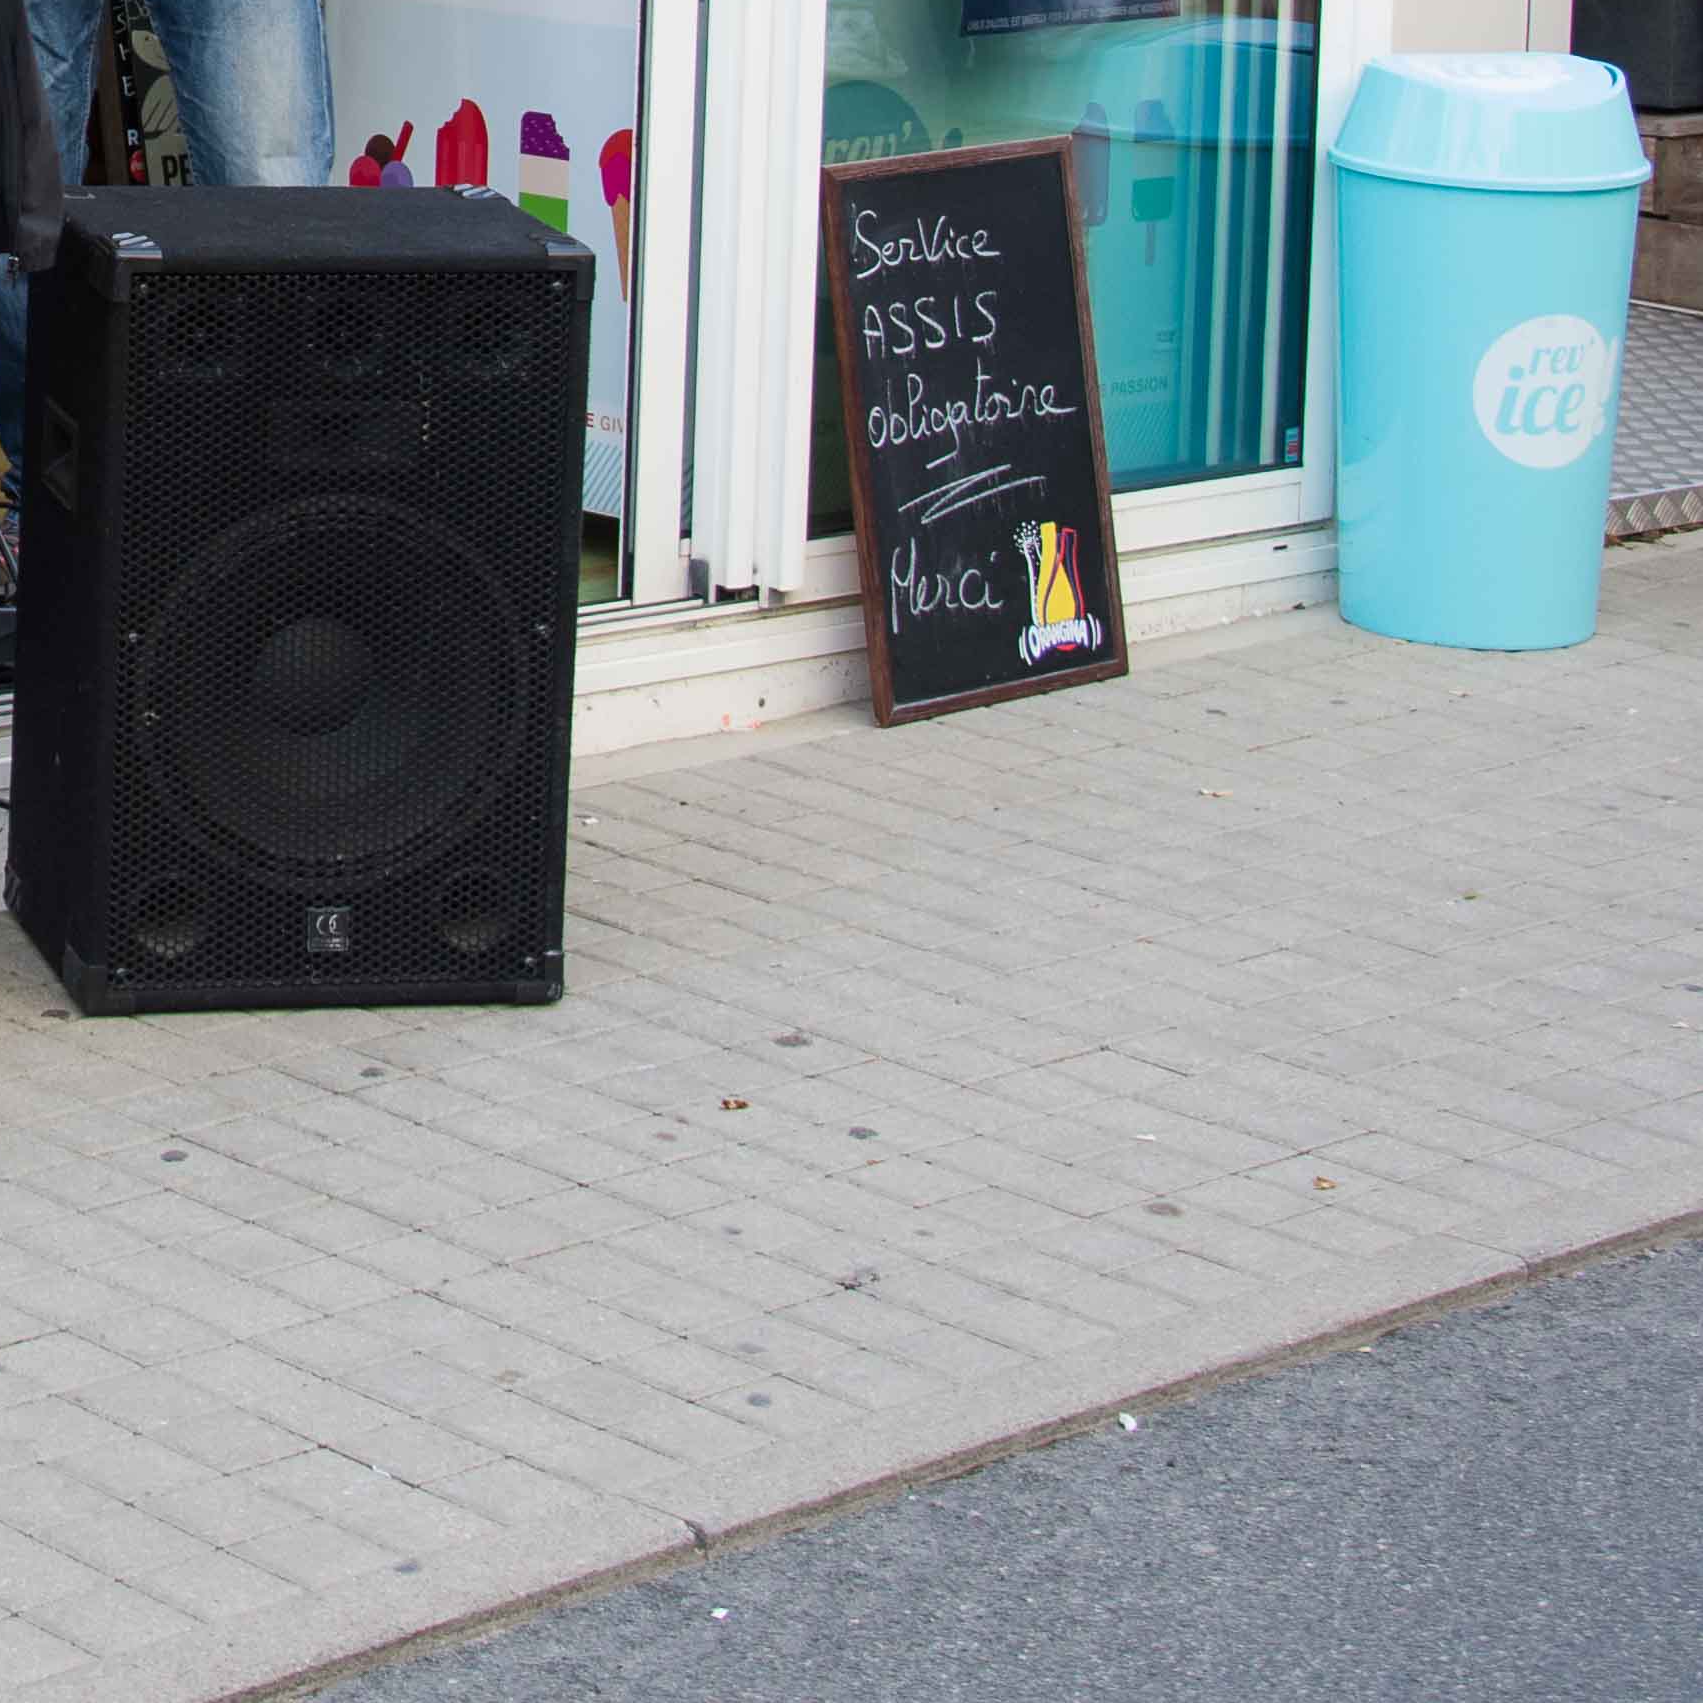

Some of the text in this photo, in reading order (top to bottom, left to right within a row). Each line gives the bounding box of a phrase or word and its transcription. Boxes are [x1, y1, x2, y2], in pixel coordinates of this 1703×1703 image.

[863, 290, 998, 356] ASSIS
[1111, 376, 1169, 396] PASSION
[1494, 364, 1586, 437] ice
[891, 536, 1004, 635] Merci
